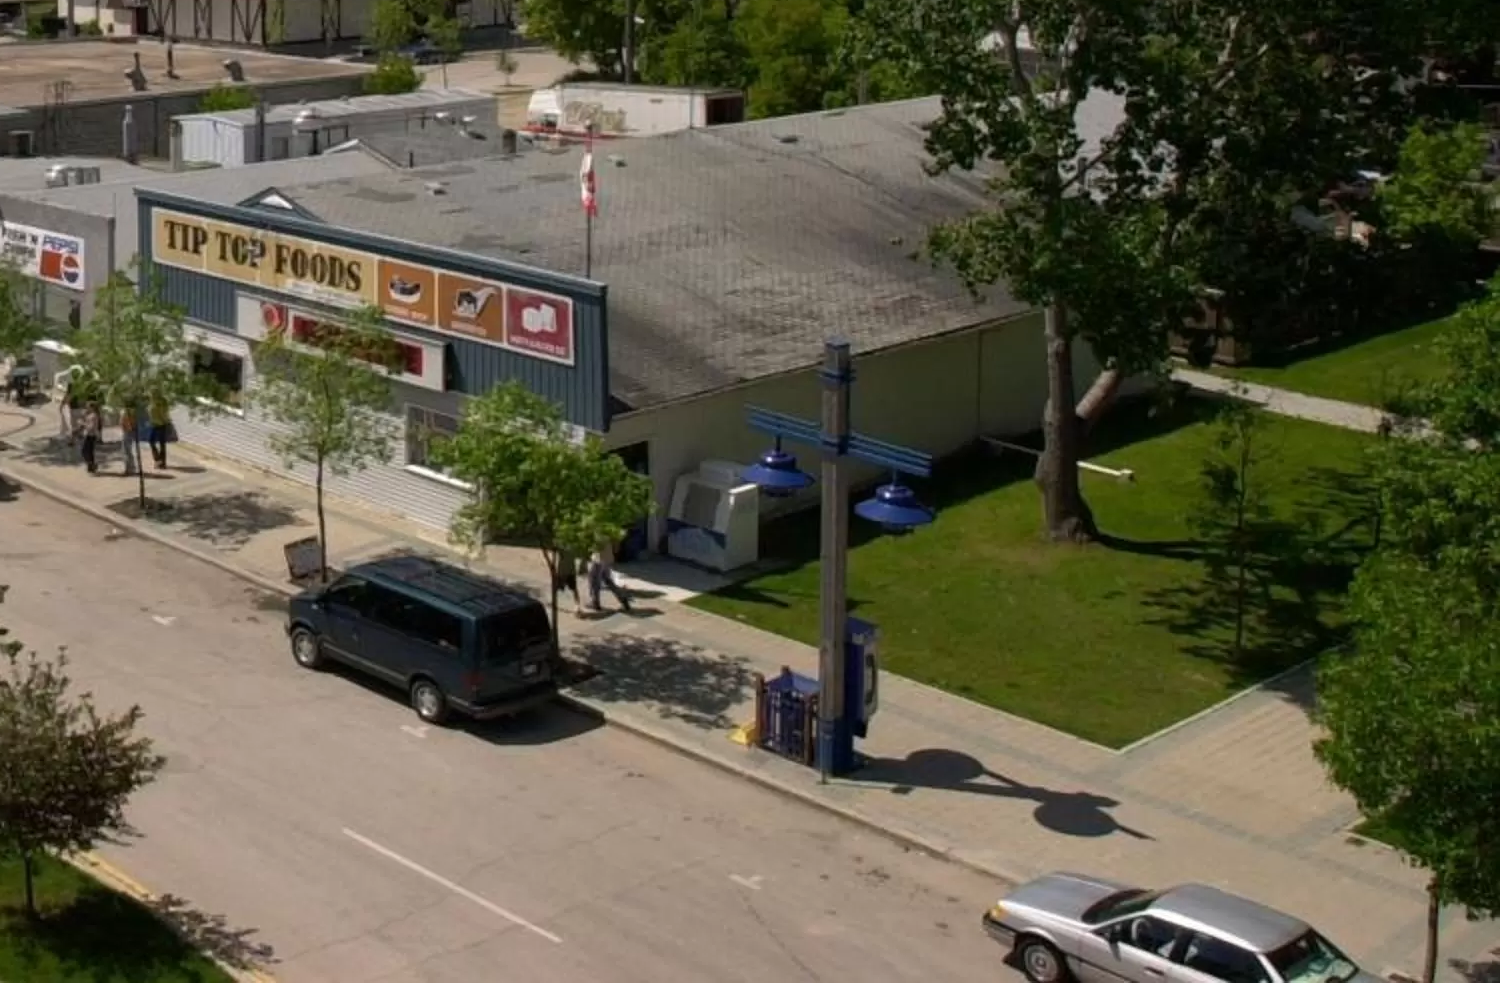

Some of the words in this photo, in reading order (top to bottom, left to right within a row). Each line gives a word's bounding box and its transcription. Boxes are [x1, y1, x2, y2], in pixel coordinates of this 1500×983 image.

[42, 233, 79, 255] PEPSI
[164, 220, 208, 255] TIP
[215, 230, 266, 268] TOP
[275, 243, 362, 292] FOODS
